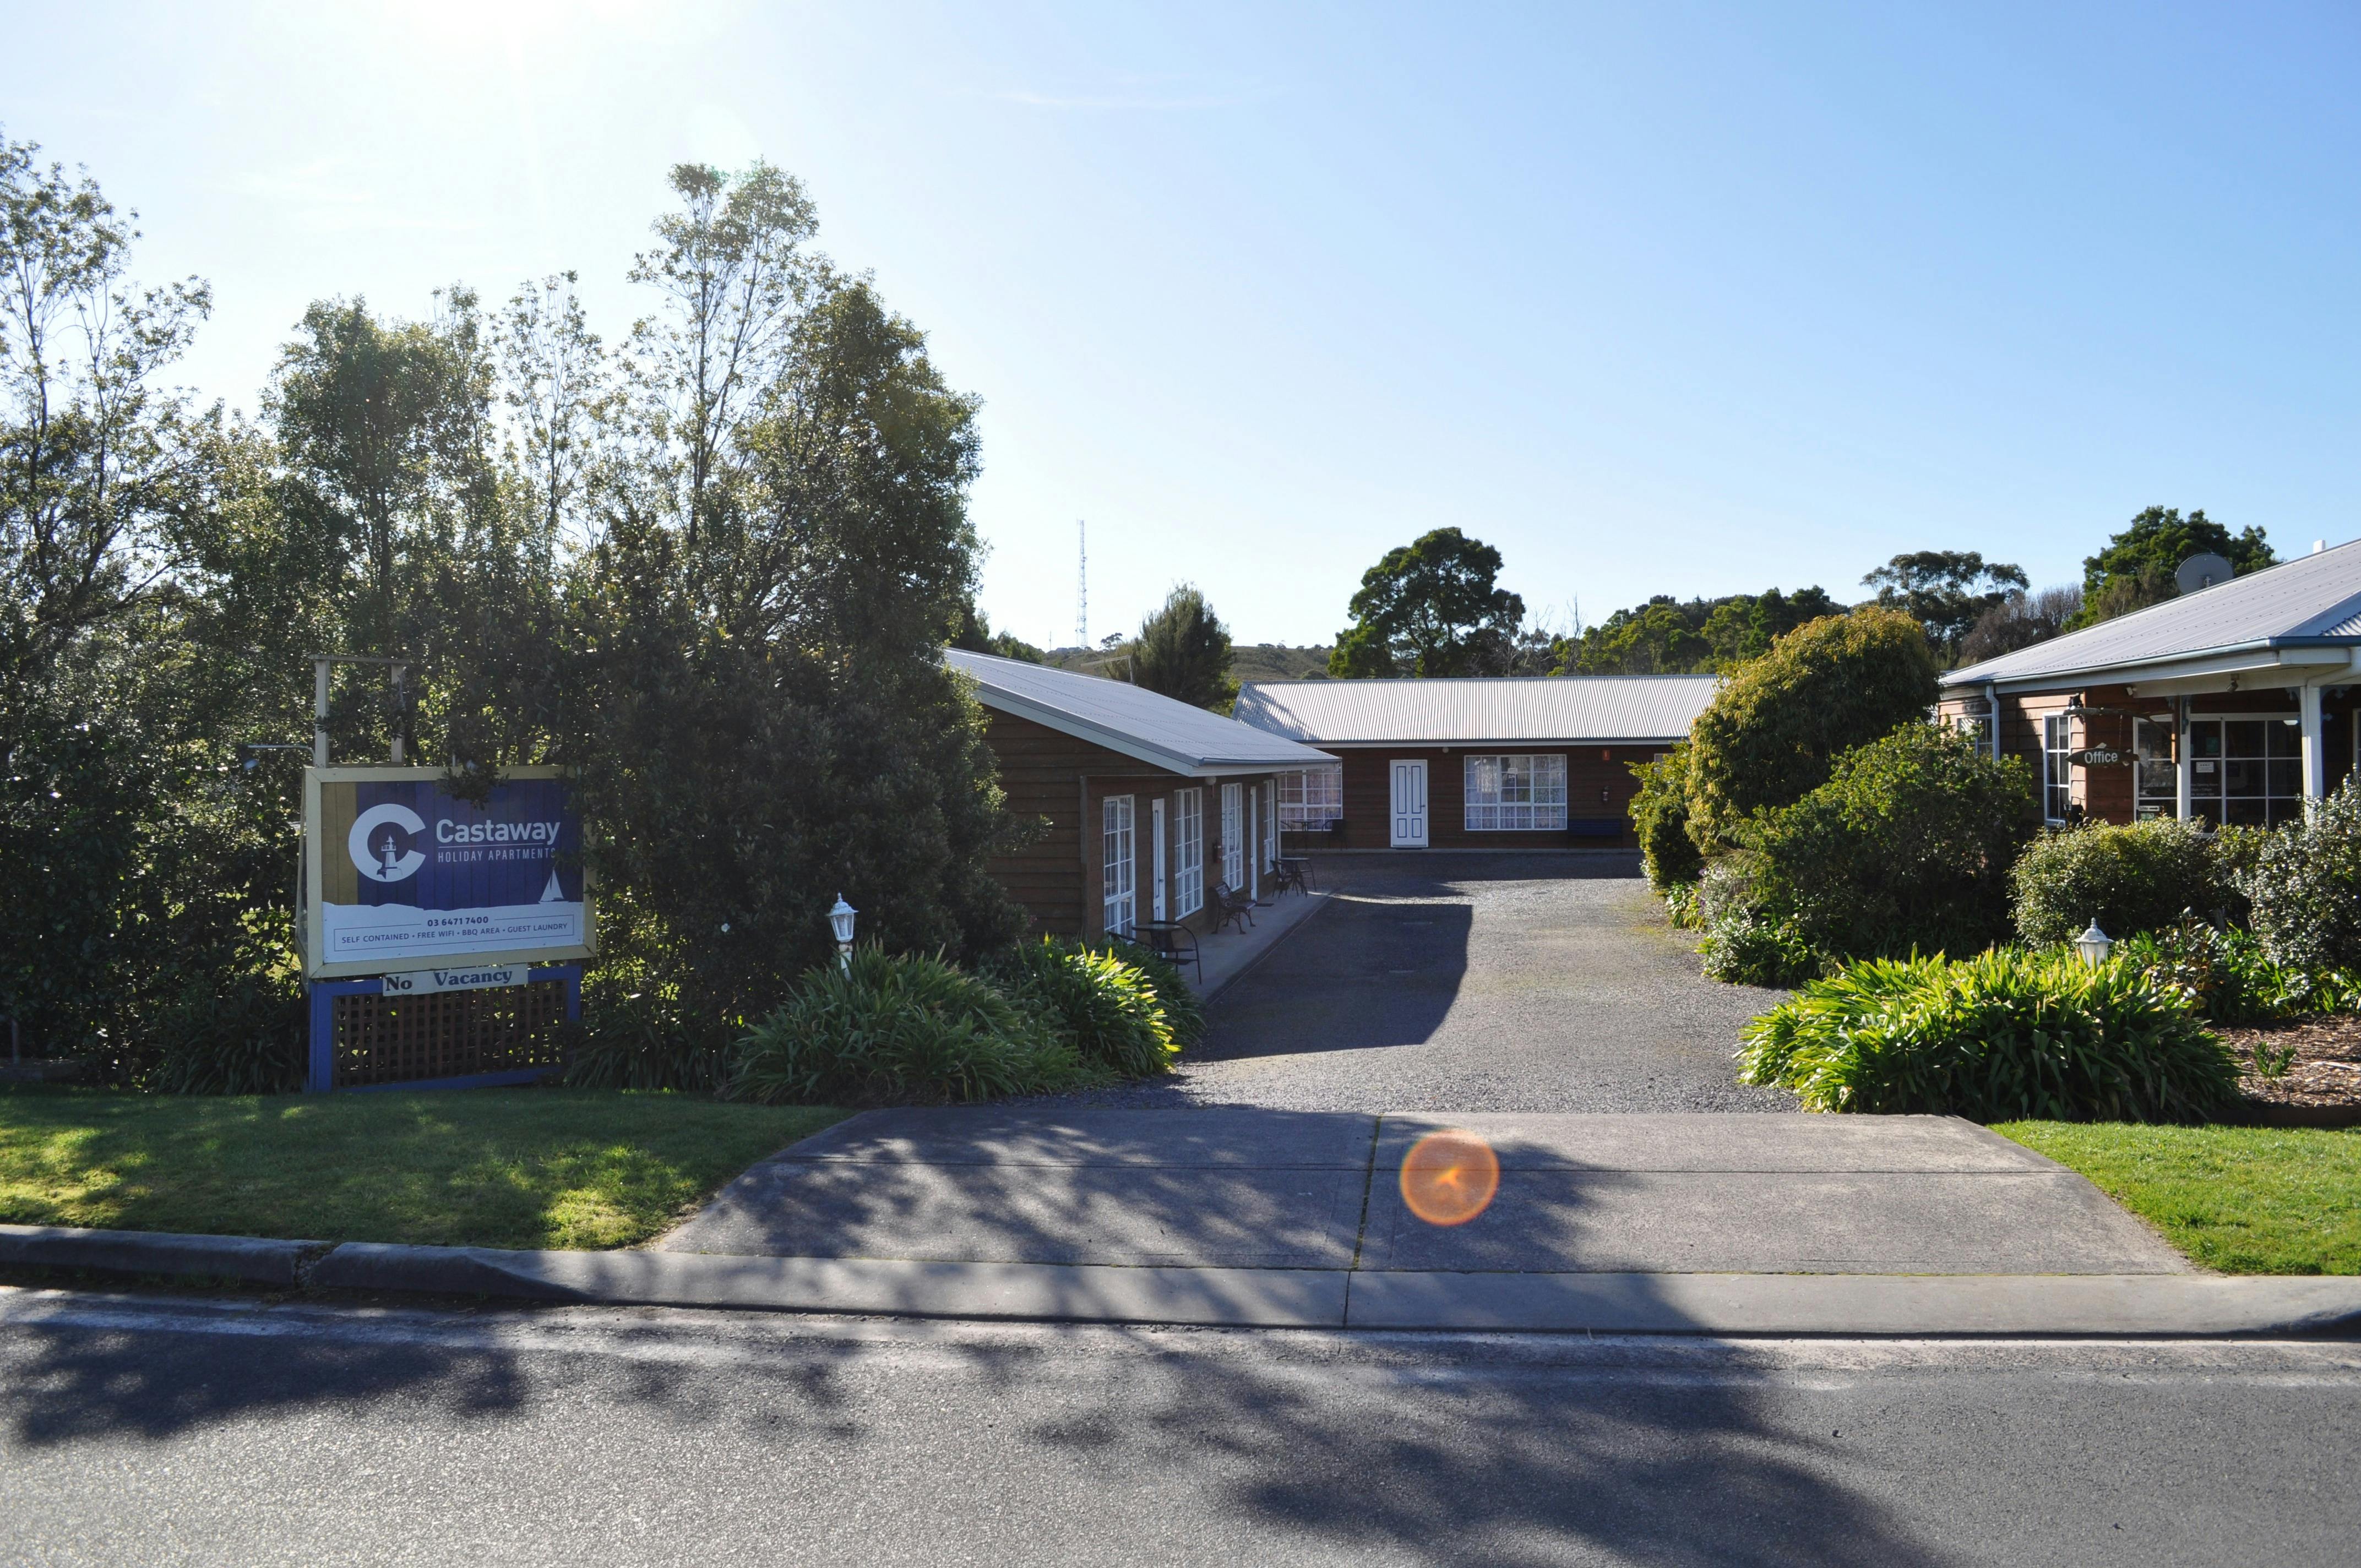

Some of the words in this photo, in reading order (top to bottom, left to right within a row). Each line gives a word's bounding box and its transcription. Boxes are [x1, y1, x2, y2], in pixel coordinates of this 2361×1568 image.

[2084, 750, 2118, 764] Office
[436, 819, 561, 845] Castaway
[348, 803, 426, 883] C
[438, 851, 483, 863] HOLIDAY
[488, 847, 556, 861] APARTMENTS
[465, 916, 489, 924] 7400
[363, 933, 410, 942] CONTAINED
[534, 923, 568, 931] LAUNDRY
[385, 976, 412, 991] No
[434, 971, 513, 986] Vacancy
